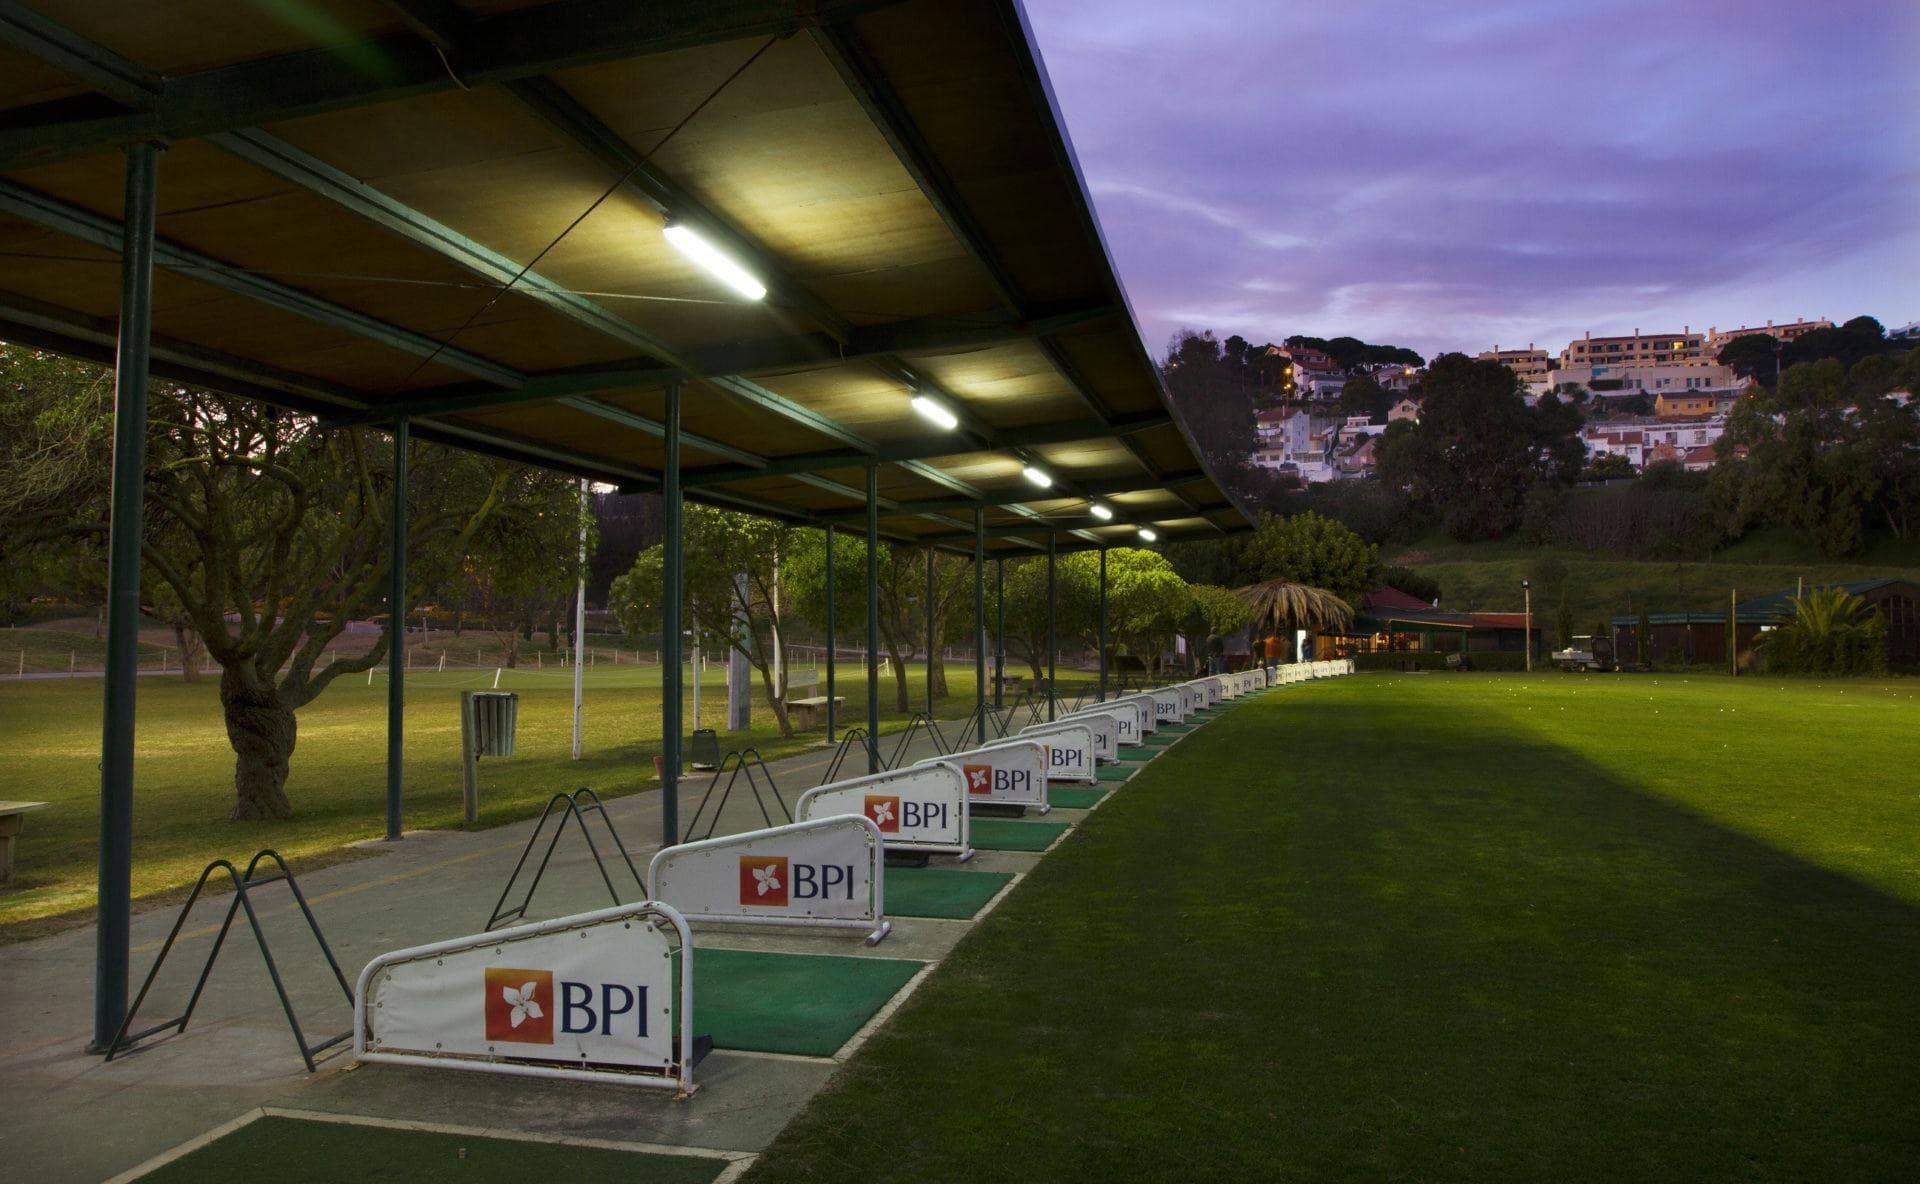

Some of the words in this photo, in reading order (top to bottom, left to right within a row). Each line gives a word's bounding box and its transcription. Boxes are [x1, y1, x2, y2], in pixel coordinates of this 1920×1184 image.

[1194, 692, 1203, 703] PI
[1208, 687, 1216, 697] PI
[1157, 703, 1176, 714] BPI
[1118, 721, 1131, 735] PI
[1094, 734, 1107, 750] PI
[1051, 748, 1082, 767] BPI
[994, 769, 1031, 791] BPI
[903, 801, 947, 829] BPI
[792, 863, 855, 900] BPI
[560, 981, 649, 1038] BPI
